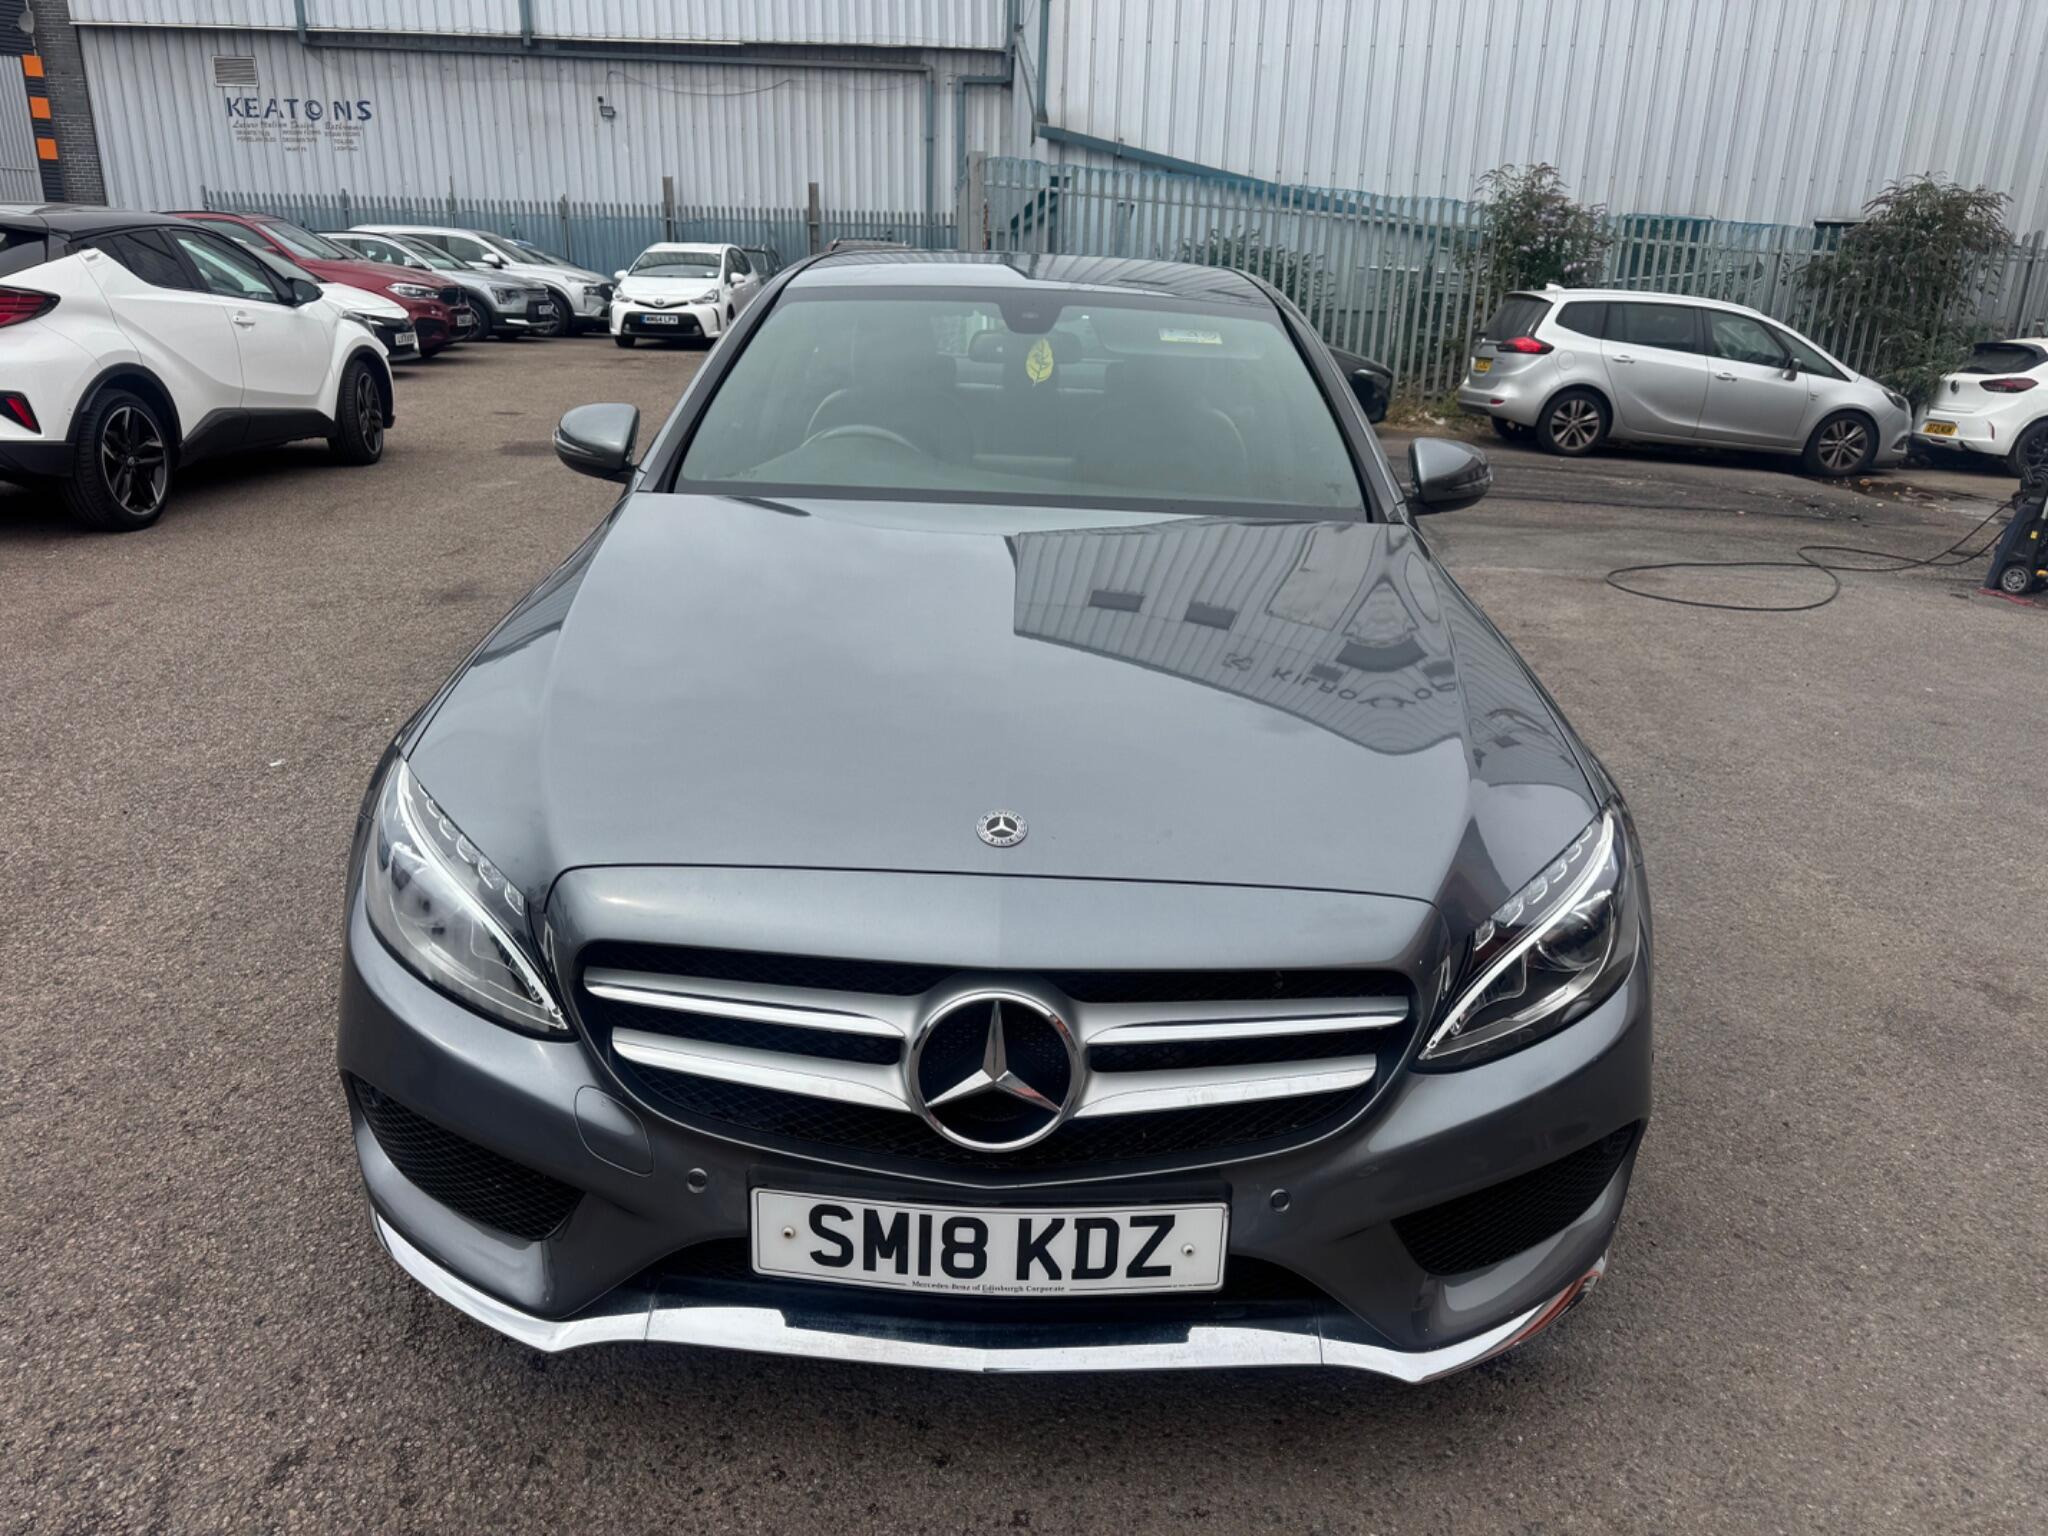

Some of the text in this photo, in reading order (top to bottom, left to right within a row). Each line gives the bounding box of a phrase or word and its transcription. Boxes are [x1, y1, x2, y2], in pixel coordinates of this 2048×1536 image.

[226, 97, 372, 121] KEATONS
[809, 1204, 1176, 1281] SM18 KDZ
[982, 1284, 1024, 1293] Edinburgh
[1026, 1285, 1065, 1293] Corporate
